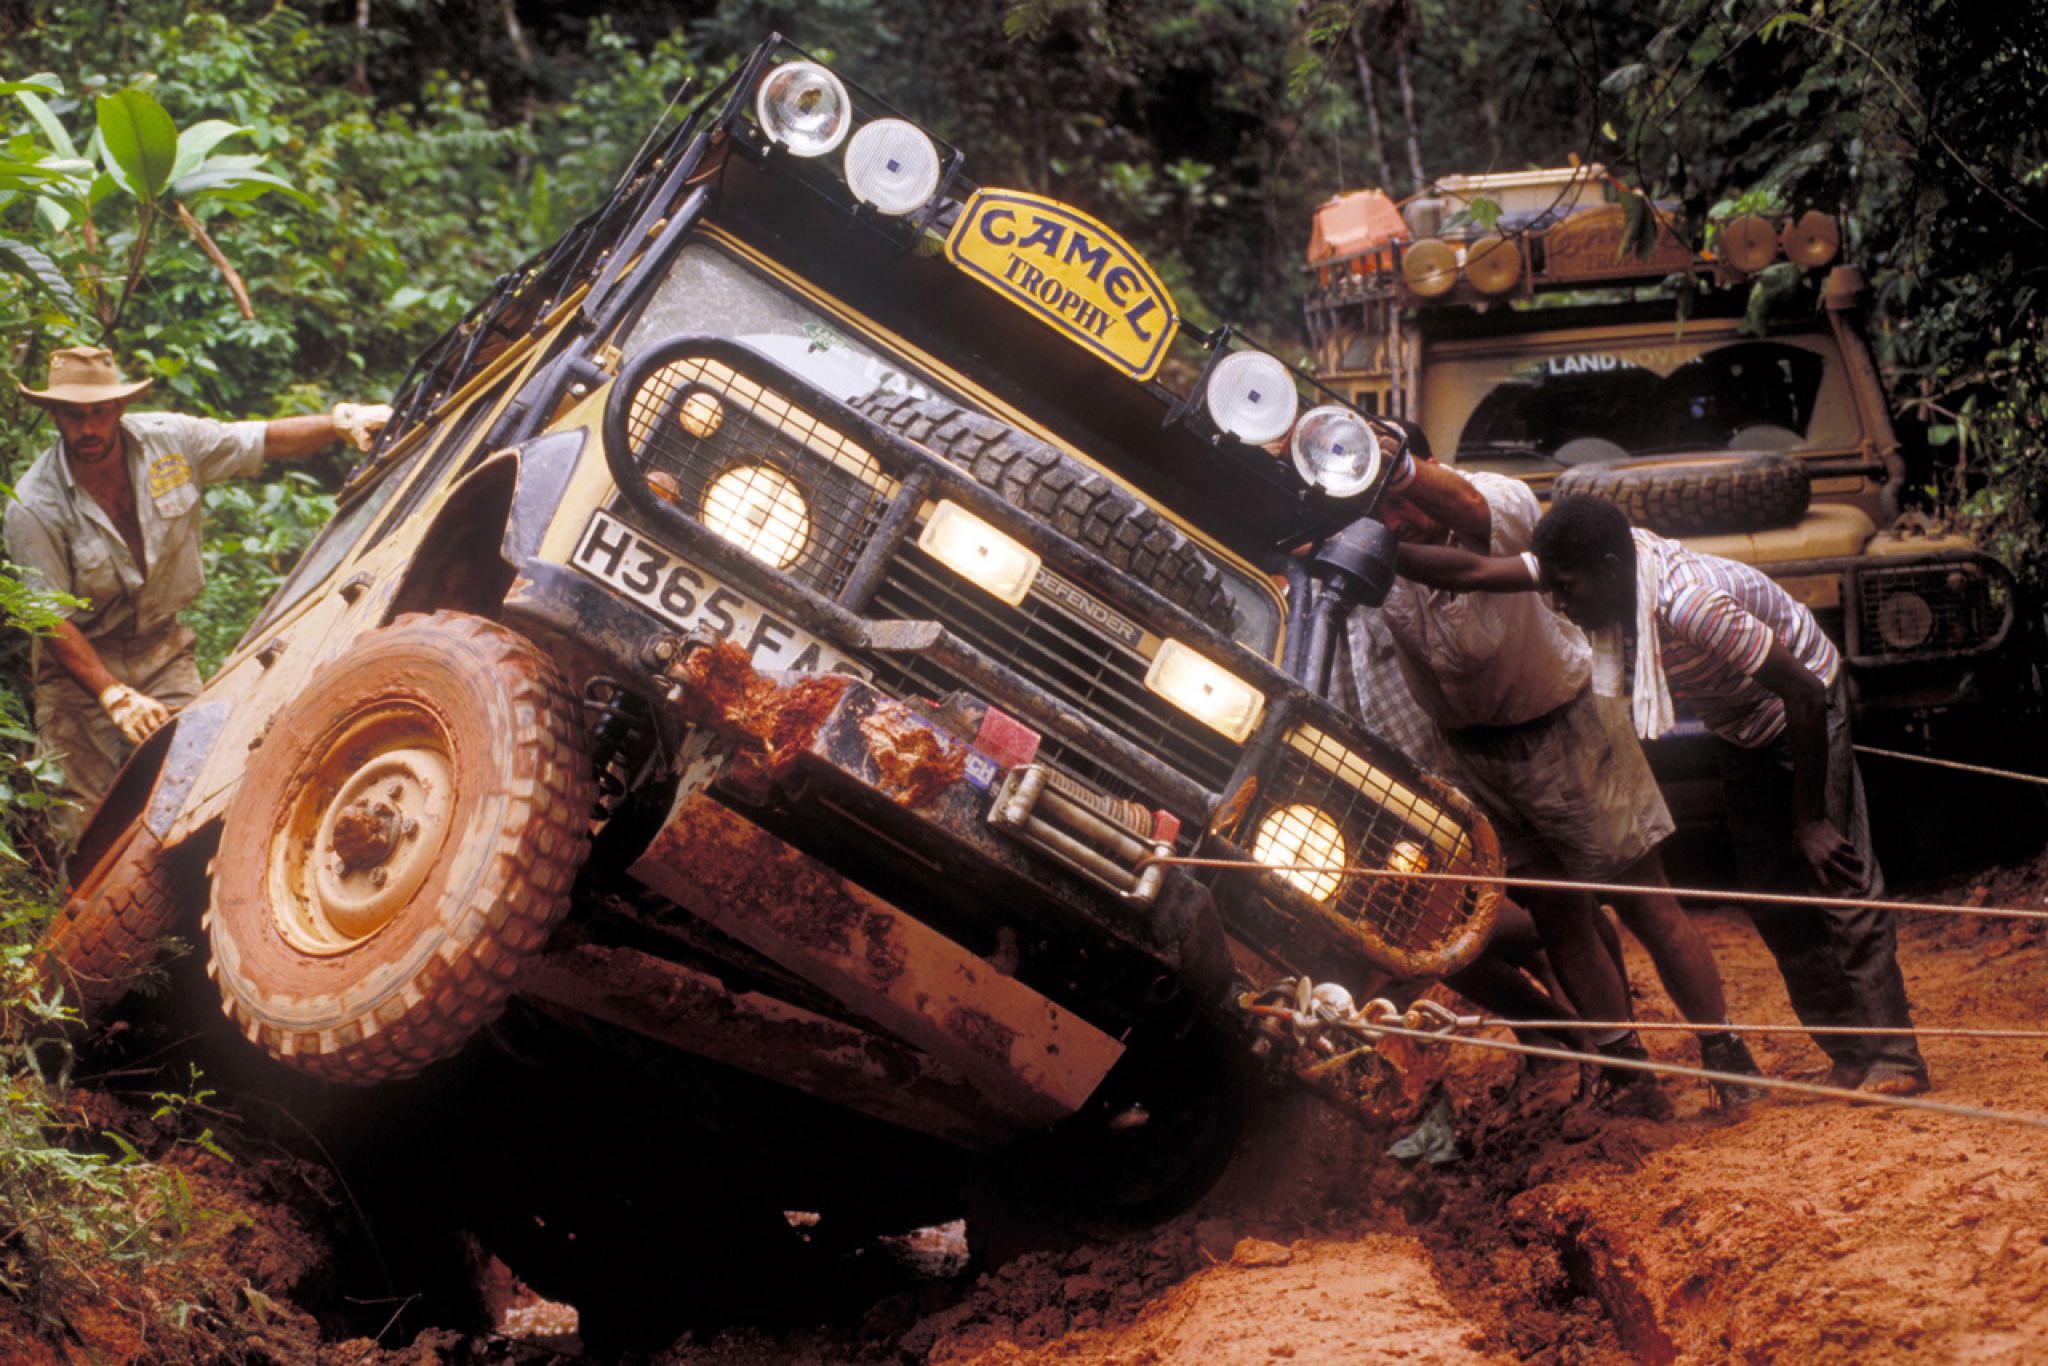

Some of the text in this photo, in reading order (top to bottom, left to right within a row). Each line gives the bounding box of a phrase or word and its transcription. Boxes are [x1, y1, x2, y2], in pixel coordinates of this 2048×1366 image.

[980, 208, 1157, 342] CAMEL
[1003, 252, 1118, 340] TROPHY
[1548, 354, 1617, 375] LAND
[580, 518, 865, 678] H365 FA
[1034, 569, 1136, 641] DEFENDER
